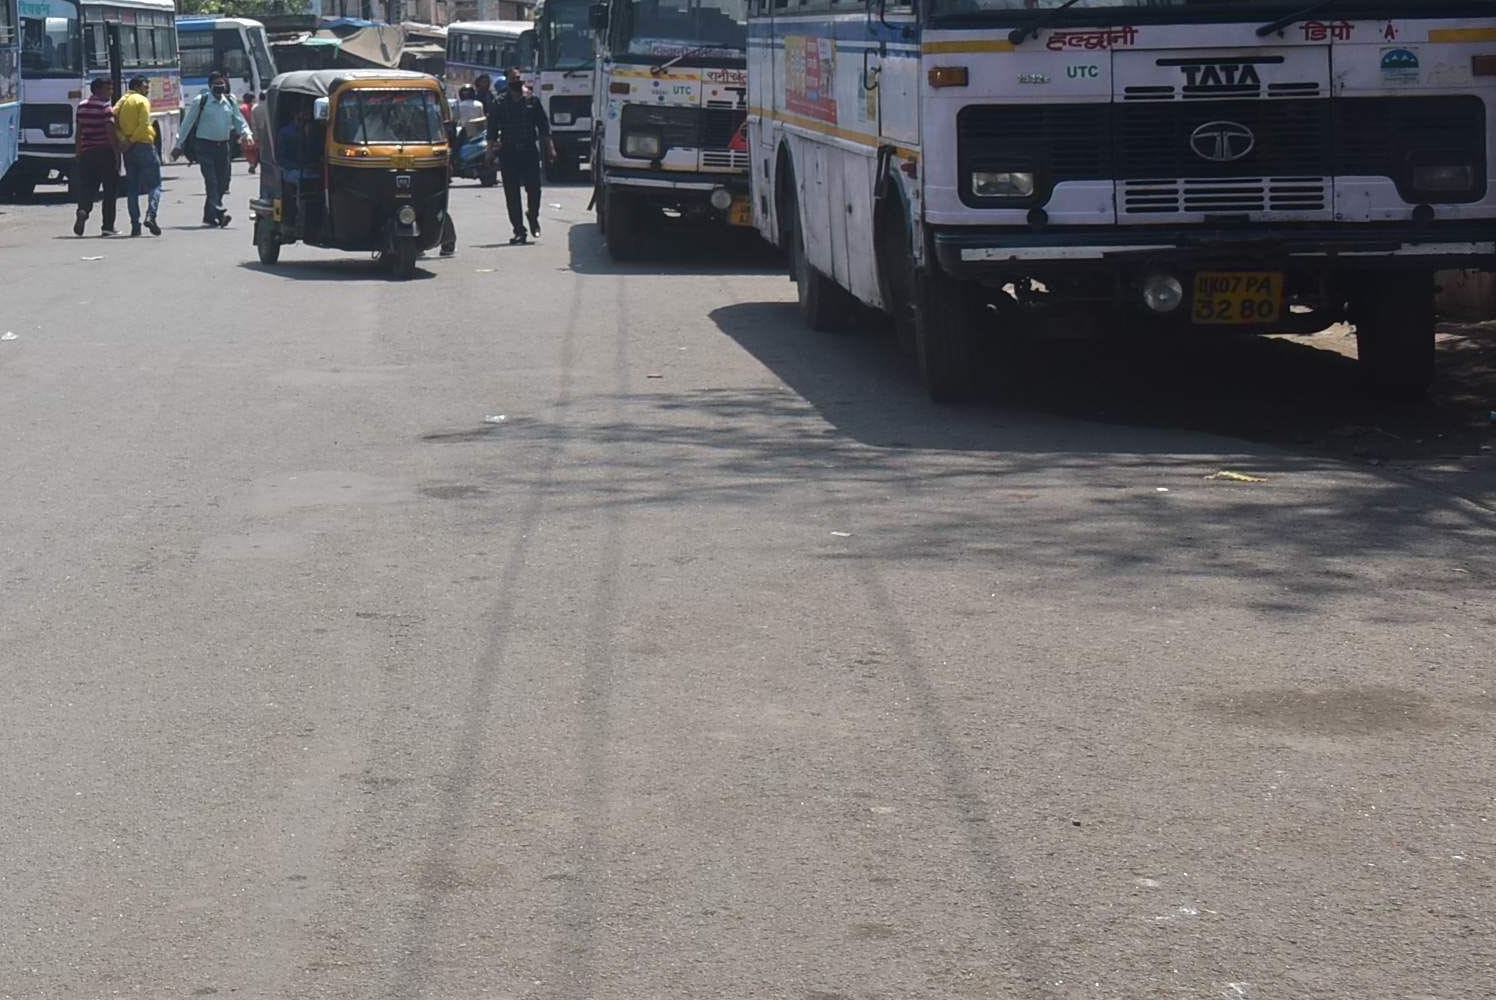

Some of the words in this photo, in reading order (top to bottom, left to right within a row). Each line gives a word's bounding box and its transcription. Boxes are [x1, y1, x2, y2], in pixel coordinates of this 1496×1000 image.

[1299, 20, 1355, 41] डिपो
[1067, 66, 1099, 79] UTC
[1180, 64, 1261, 86] TATA
[673, 86, 692, 96] UTC
